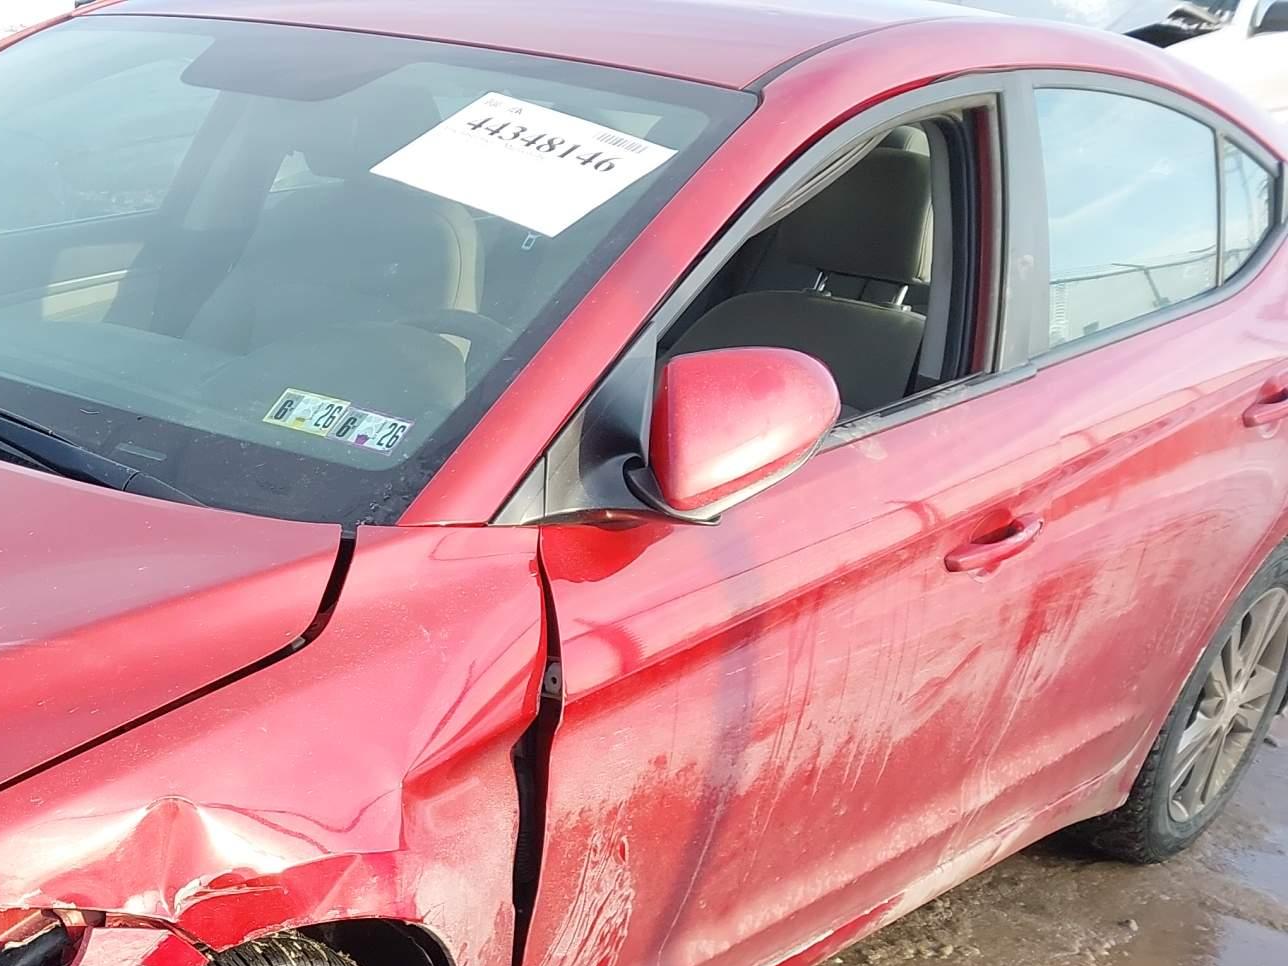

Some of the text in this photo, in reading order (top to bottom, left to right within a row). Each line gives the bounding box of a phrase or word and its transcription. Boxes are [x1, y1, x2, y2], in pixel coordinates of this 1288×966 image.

[466, 117, 623, 172] 44348146
[274, 400, 343, 429] 6 26
[336, 417, 407, 448] 6 26
